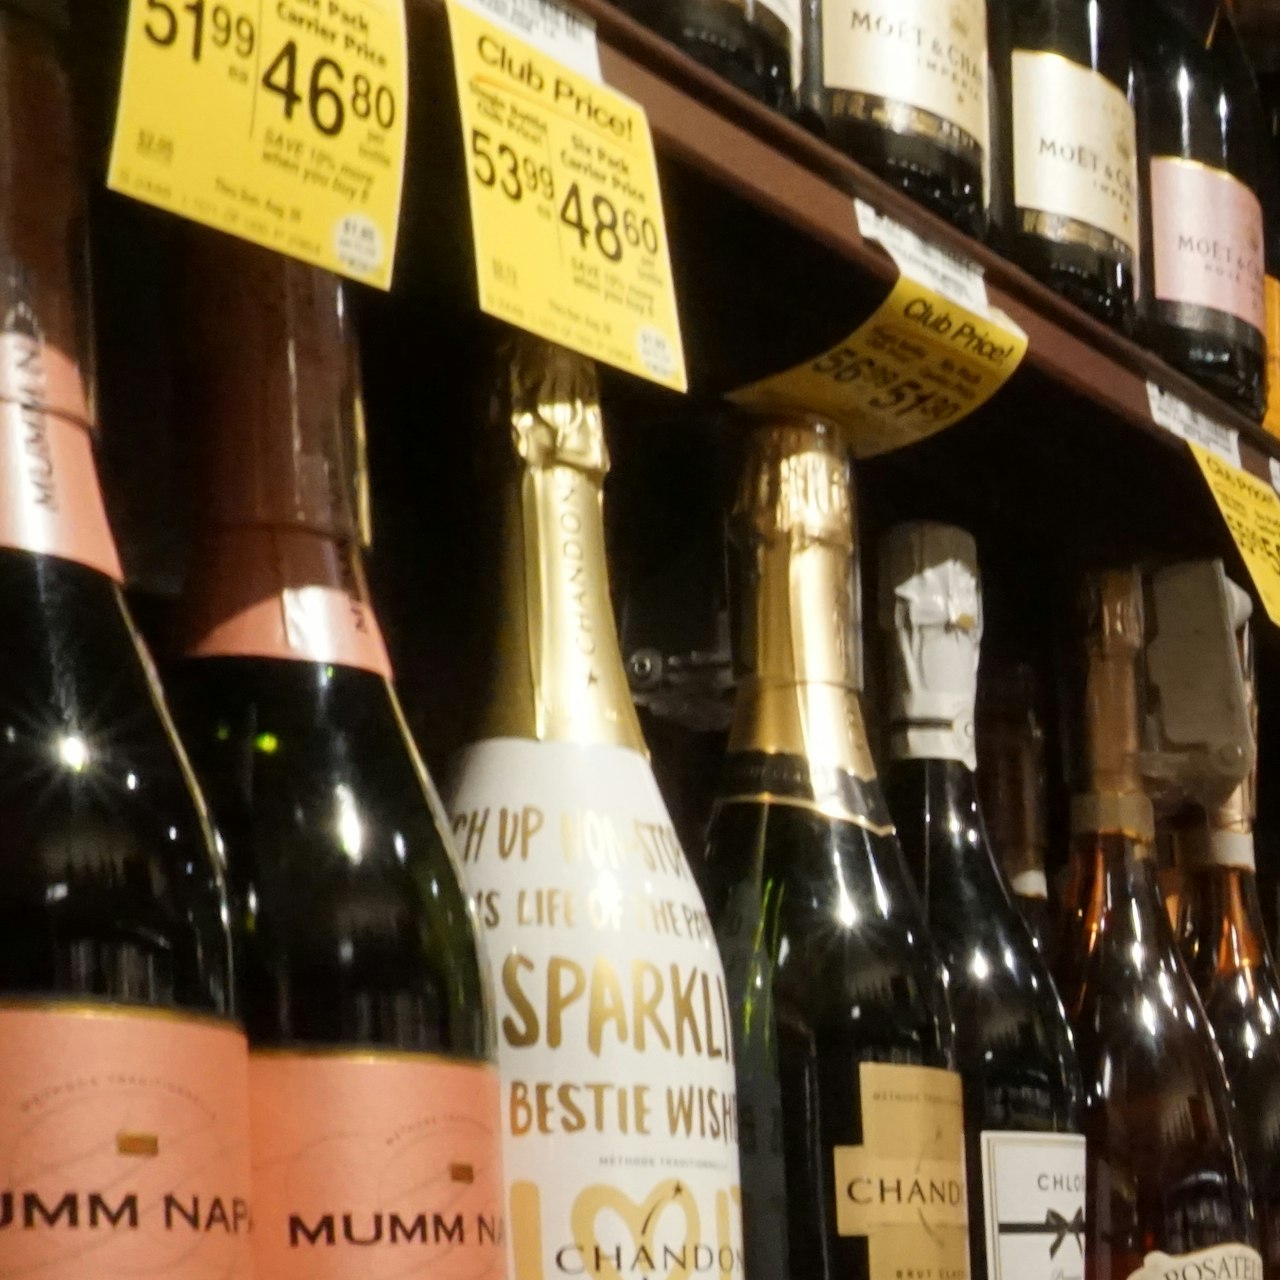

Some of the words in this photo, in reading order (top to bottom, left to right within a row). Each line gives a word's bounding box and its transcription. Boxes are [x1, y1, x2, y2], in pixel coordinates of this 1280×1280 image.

[476, 35, 544, 92] Club
[553, 77, 634, 142] Price!
[903, 298, 952, 334] Club
[556, 483, 596, 653] CHANDON
[498, 804, 544, 862] UP
[517, 888, 576, 930] LIFE
[508, 1077, 654, 1138] BESTIE
[288, 1211, 465, 1248] MUMM
